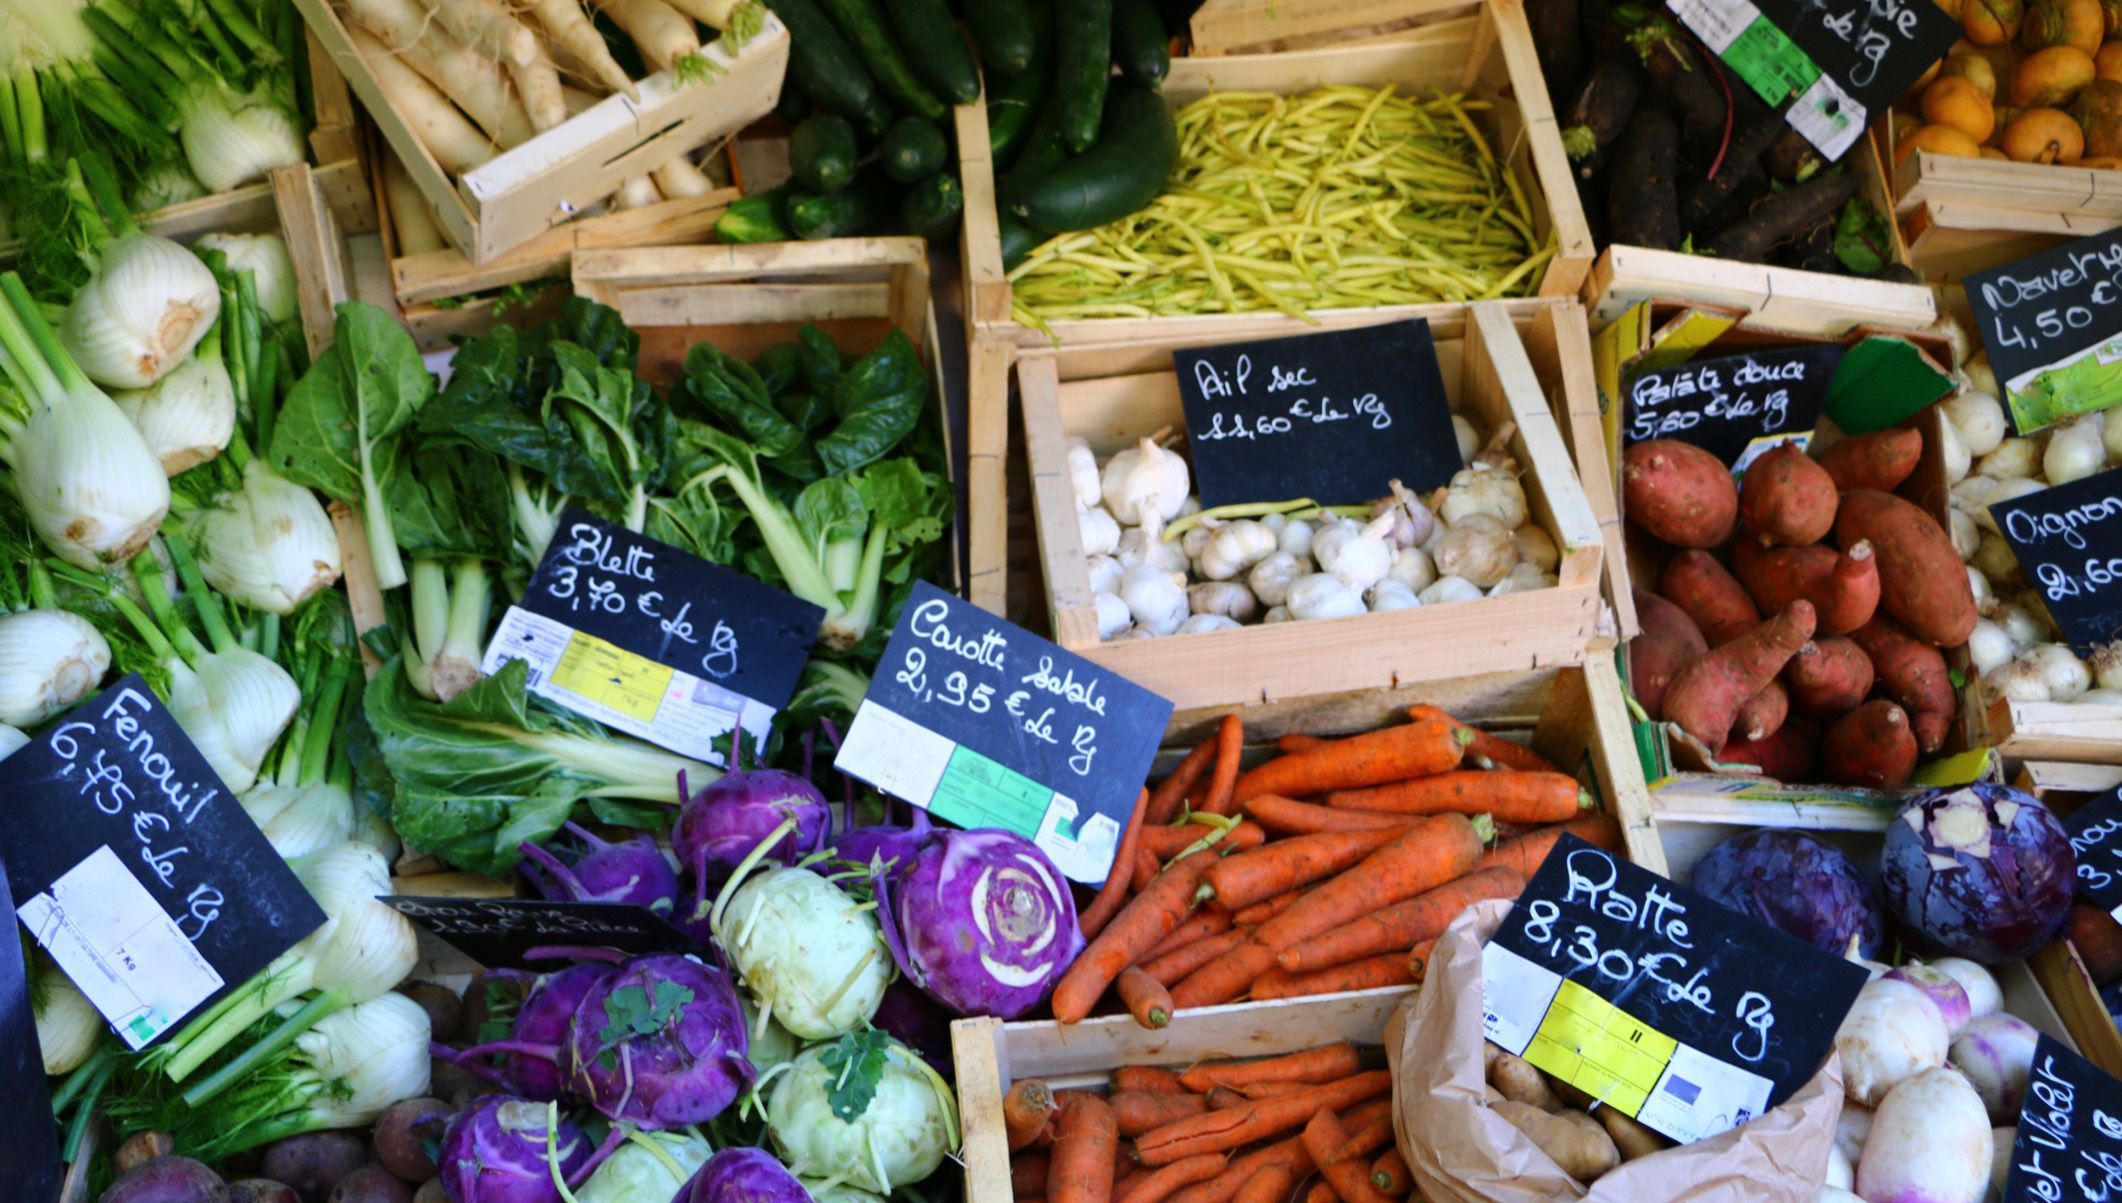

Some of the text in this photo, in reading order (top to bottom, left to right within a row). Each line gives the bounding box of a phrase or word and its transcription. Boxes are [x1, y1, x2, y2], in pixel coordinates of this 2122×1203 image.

[1994, 306, 2092, 350] 4,50
[1194, 354, 1317, 401] Ail sec
[1732, 359, 1806, 387] douce
[565, 523, 656, 583] Blette
[910, 599, 1008, 672] Carotte
[895, 647, 997, 714] 2,95
[50, 722, 136, 815] 6,75
[102, 688, 219, 824] Fenouil
[1563, 849, 1695, 949] Ratte
[1524, 899, 1634, 982] 8,30
[2021, 1054, 2076, 1150] Violet
